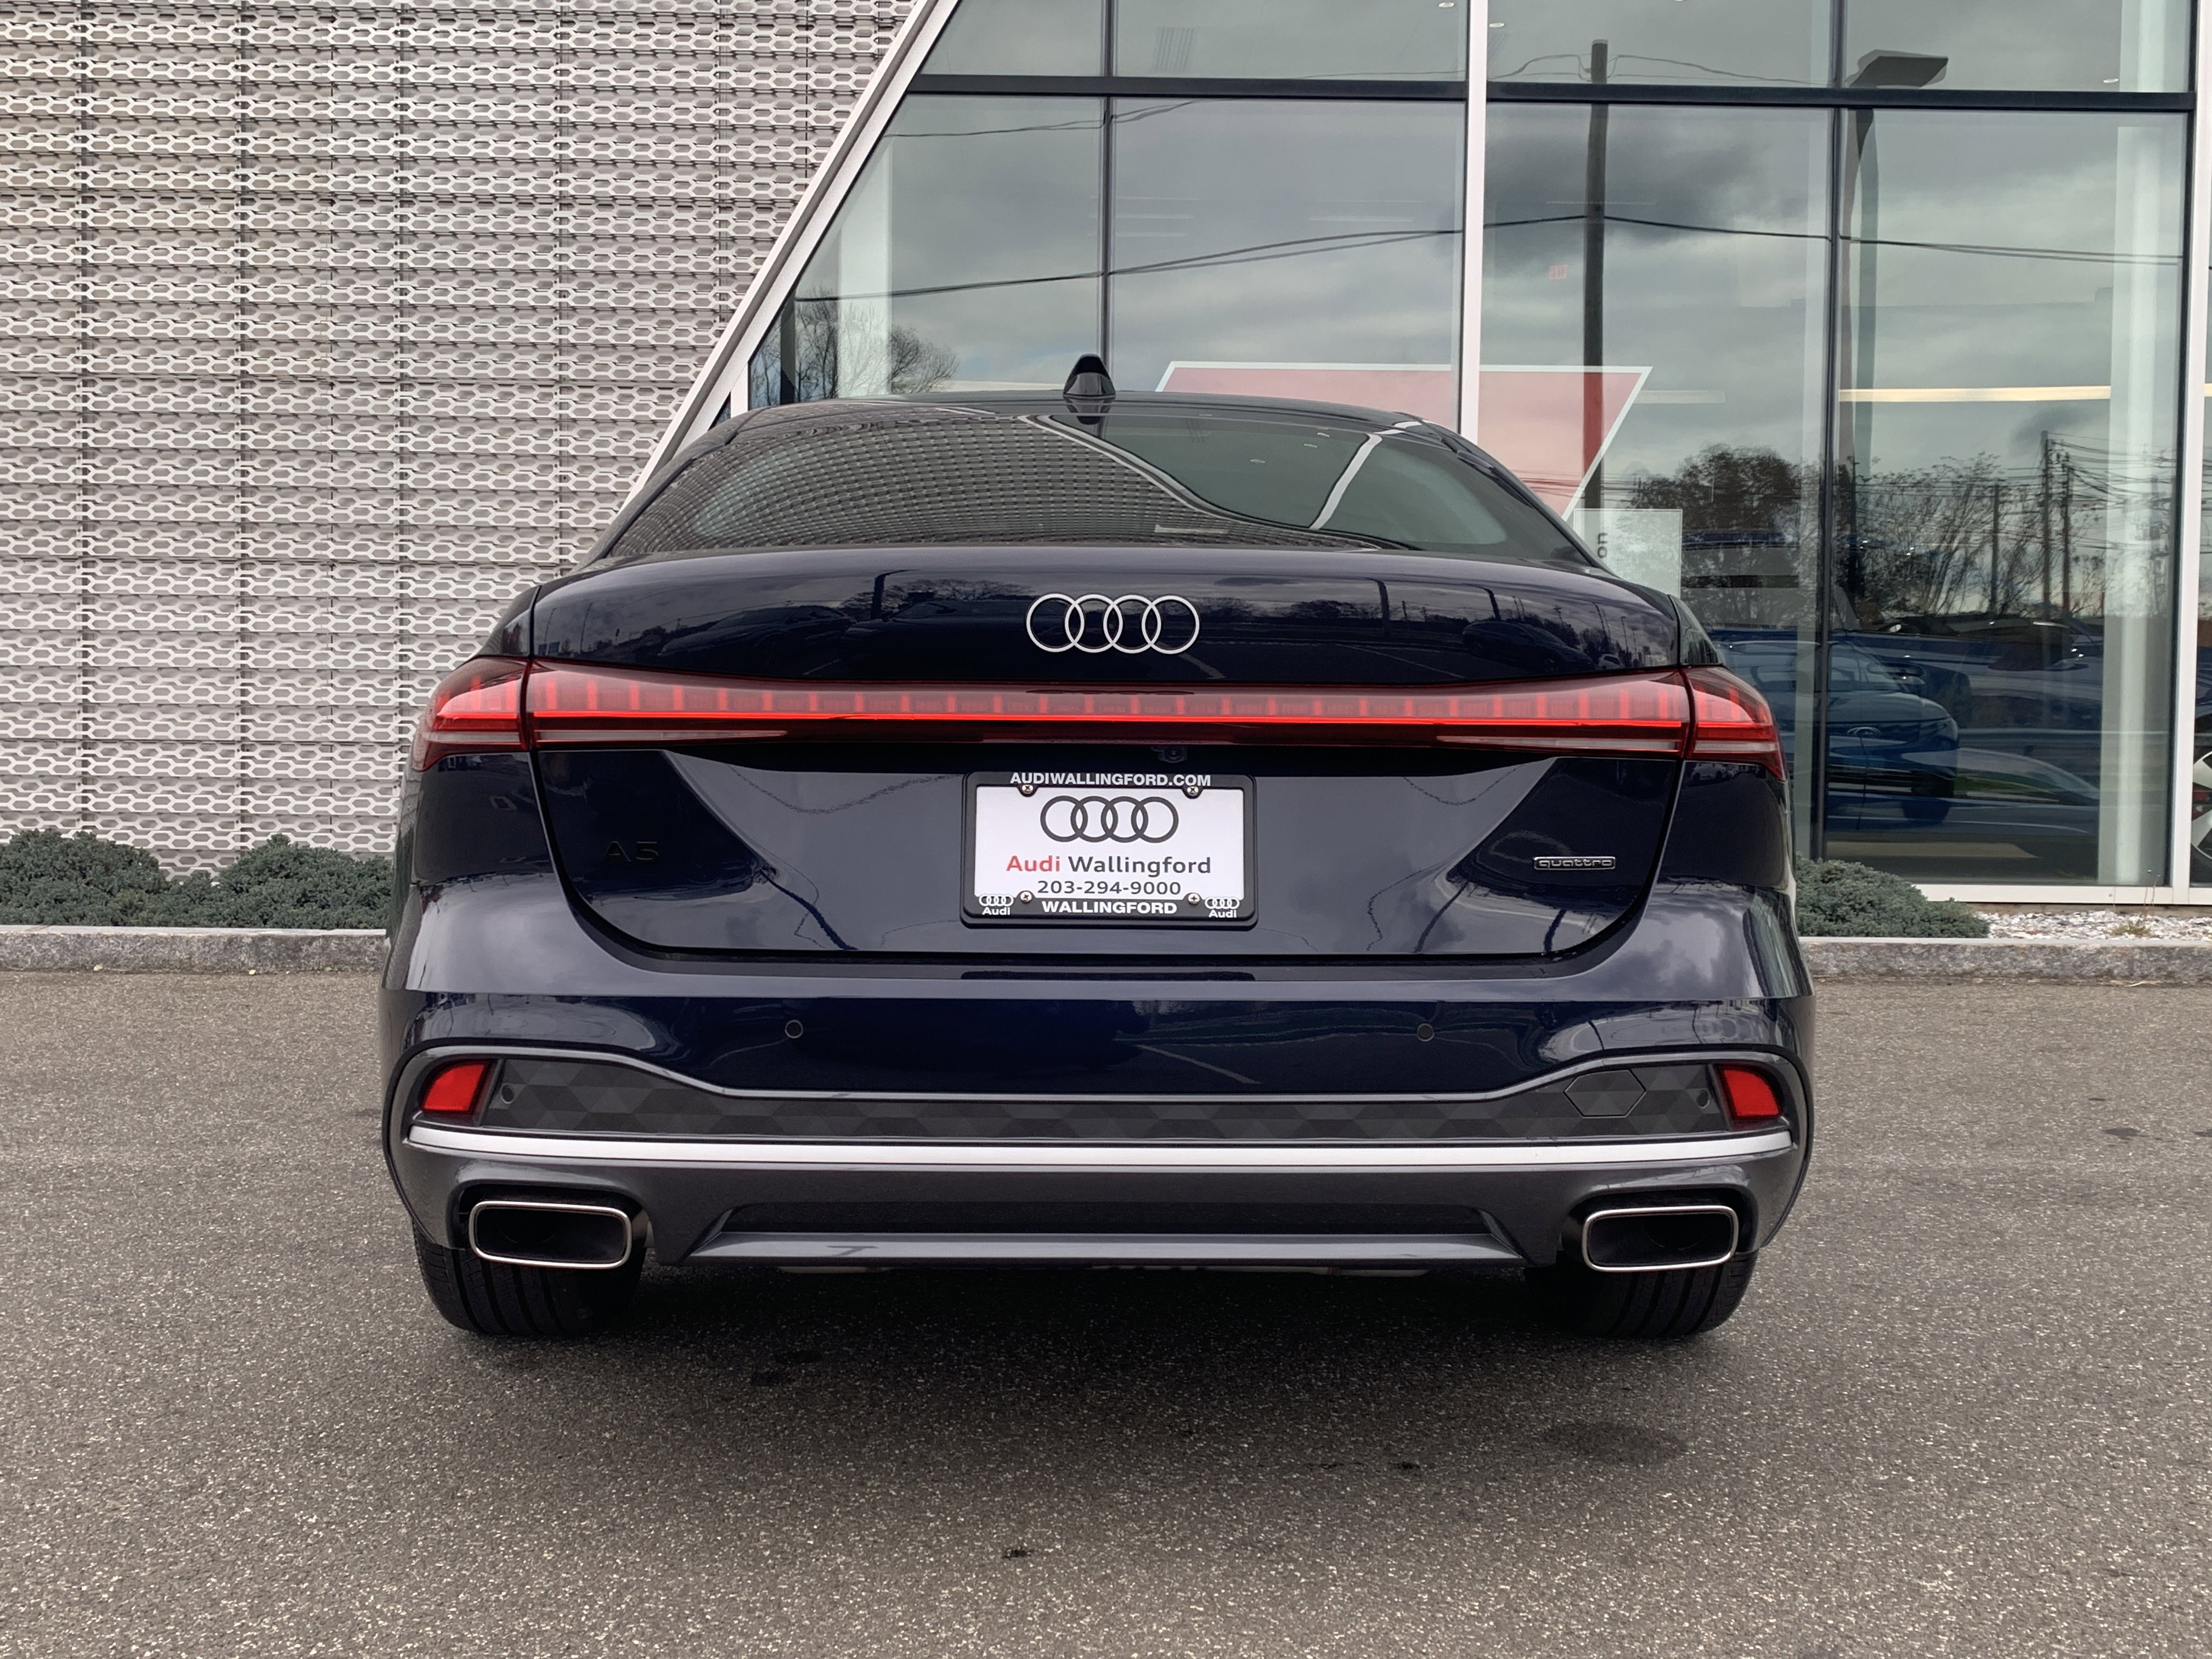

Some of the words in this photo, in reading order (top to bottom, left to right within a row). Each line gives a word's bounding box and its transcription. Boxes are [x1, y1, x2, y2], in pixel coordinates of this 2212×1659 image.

[1010, 772, 1211, 787] AUDIWALLINGFORD.COM
[602, 840, 659, 864] A5
[1006, 855, 1060, 872] Audi
[1068, 856, 1211, 878] Wallingford
[1539, 859, 1612, 868] quattro
[1037, 880, 1181, 895] 203-294-9000
[981, 906, 1011, 916] Audi
[1042, 901, 1177, 915] WALLINGFORD
[1208, 909, 1237, 919] Audi
